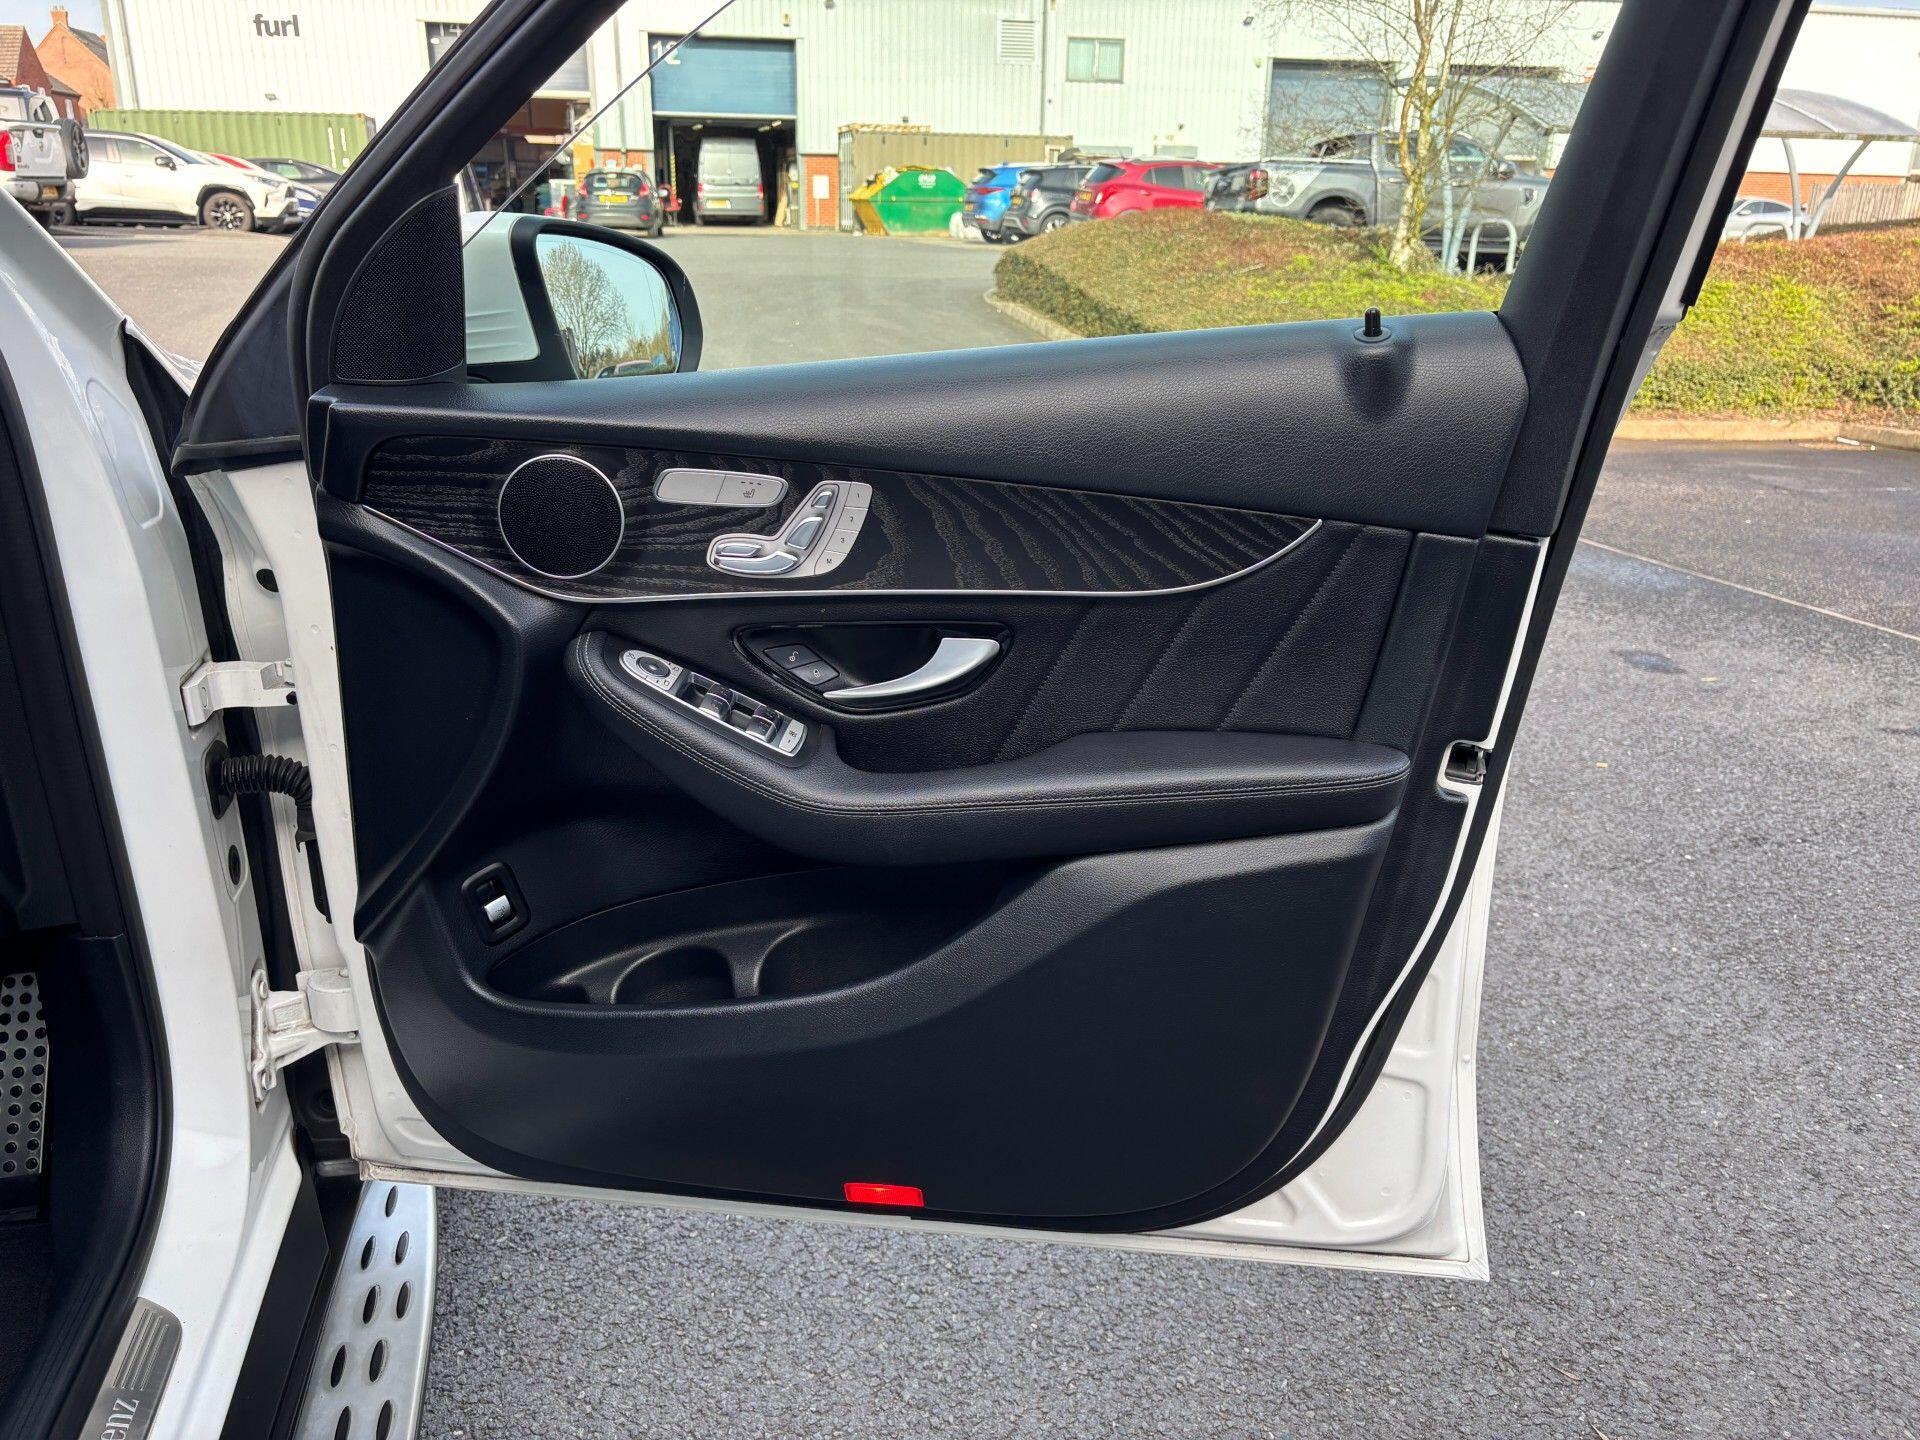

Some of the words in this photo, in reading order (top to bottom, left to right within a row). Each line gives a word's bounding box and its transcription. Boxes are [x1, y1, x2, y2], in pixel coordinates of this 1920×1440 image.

[253, 13, 300, 37] furl
[652, 40, 681, 65] 12
[100, 1397, 140, 1440] enz
